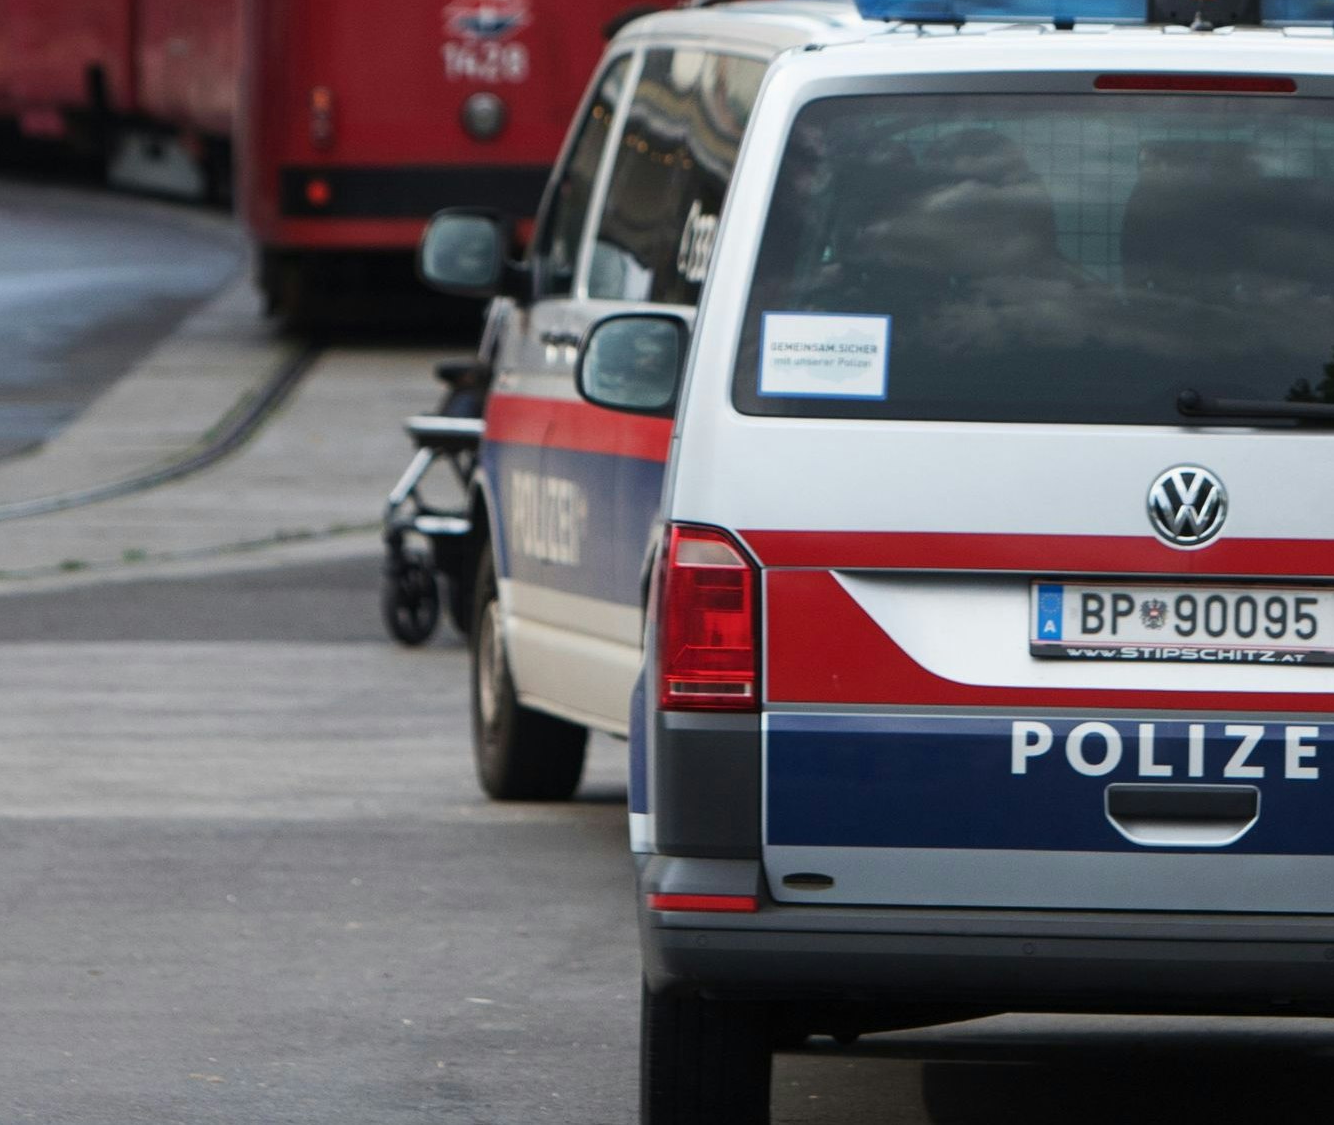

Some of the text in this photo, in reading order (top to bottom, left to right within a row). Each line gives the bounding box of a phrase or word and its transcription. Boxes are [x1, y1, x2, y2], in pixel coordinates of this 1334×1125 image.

[1043, 592, 1319, 640] A BP 90095
[1066, 646, 1307, 663] www.STIPSCHITZ.AT
